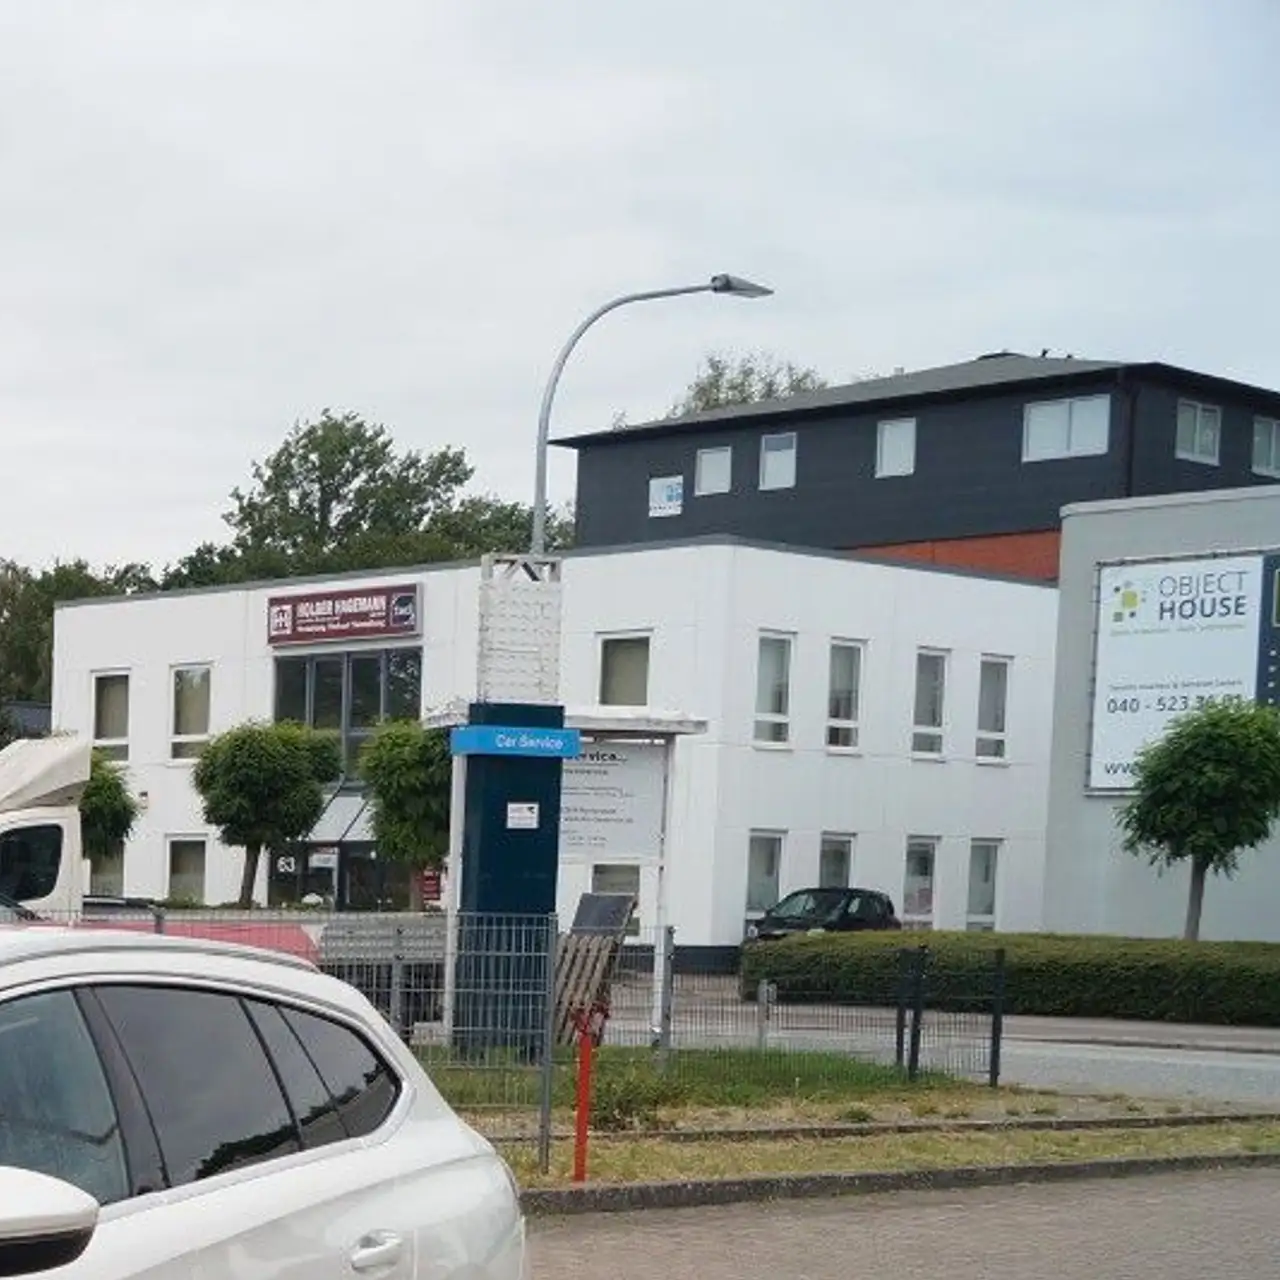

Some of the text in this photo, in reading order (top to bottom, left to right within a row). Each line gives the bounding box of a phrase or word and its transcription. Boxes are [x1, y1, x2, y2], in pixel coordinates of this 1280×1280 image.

[1158, 571, 1251, 599] OBJECT
[1159, 596, 1246, 620] HOUSE
[1107, 697, 1140, 714] 040
[495, 735, 564, 750] Car Service
